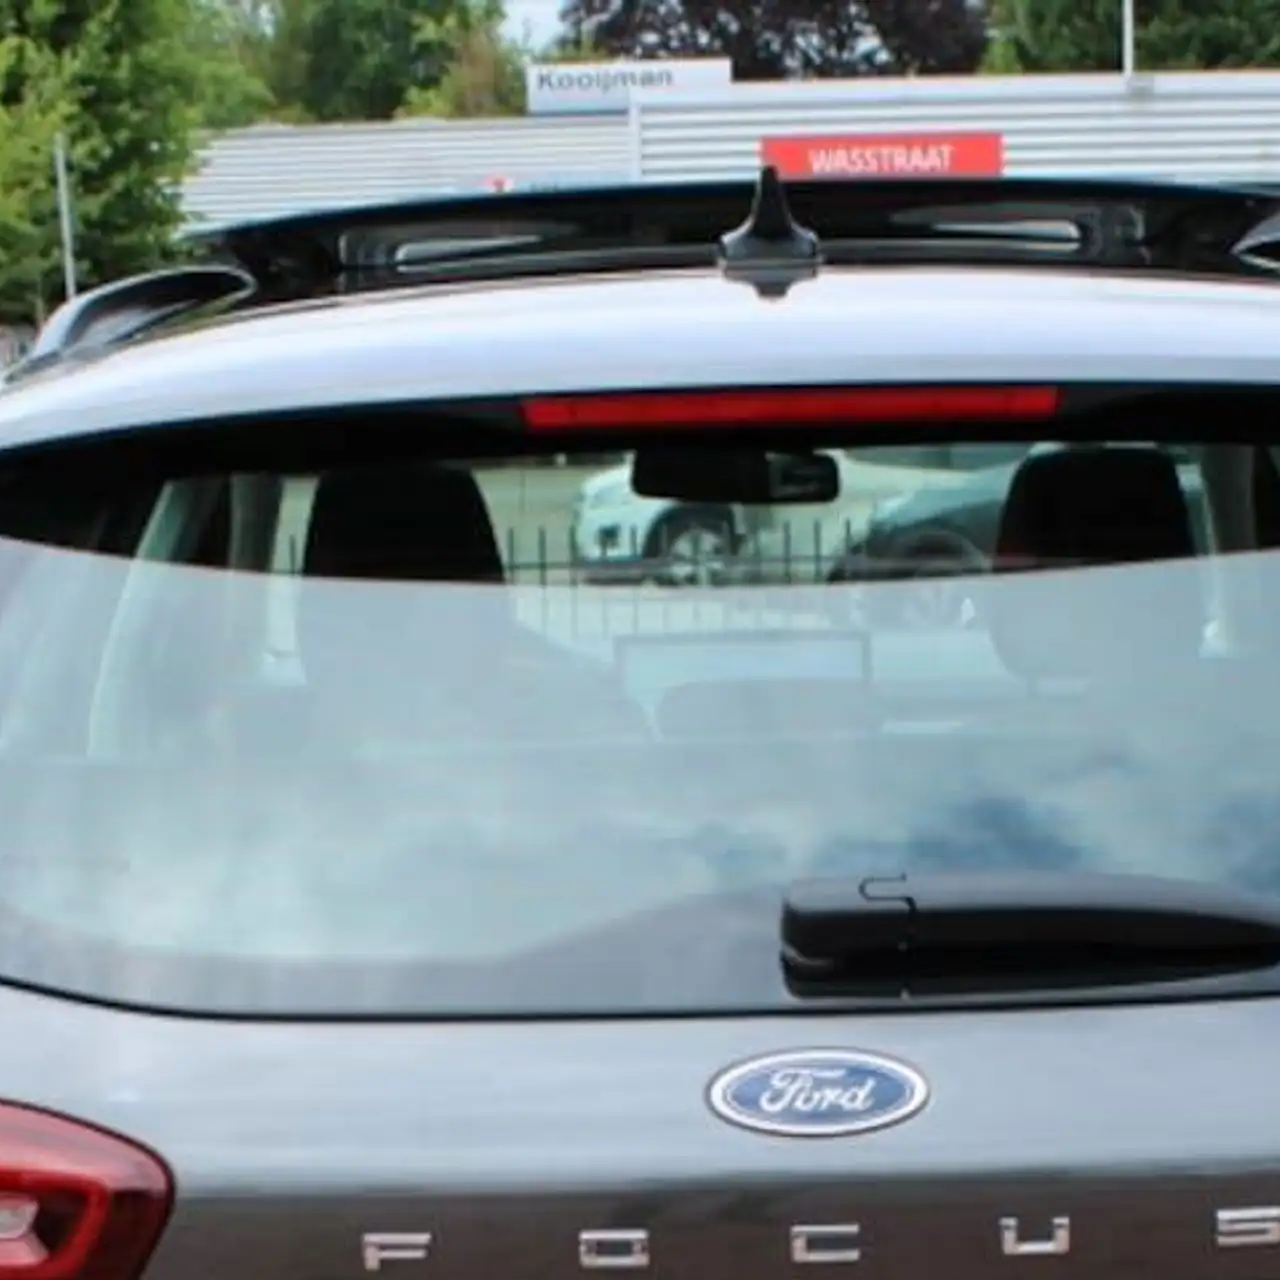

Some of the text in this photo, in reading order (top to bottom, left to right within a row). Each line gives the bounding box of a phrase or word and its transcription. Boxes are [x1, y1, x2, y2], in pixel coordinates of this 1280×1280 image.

[538, 68, 673, 92] Kooijman
[808, 144, 954, 173] WASSTRAAT
[759, 1067, 876, 1112] Ford
